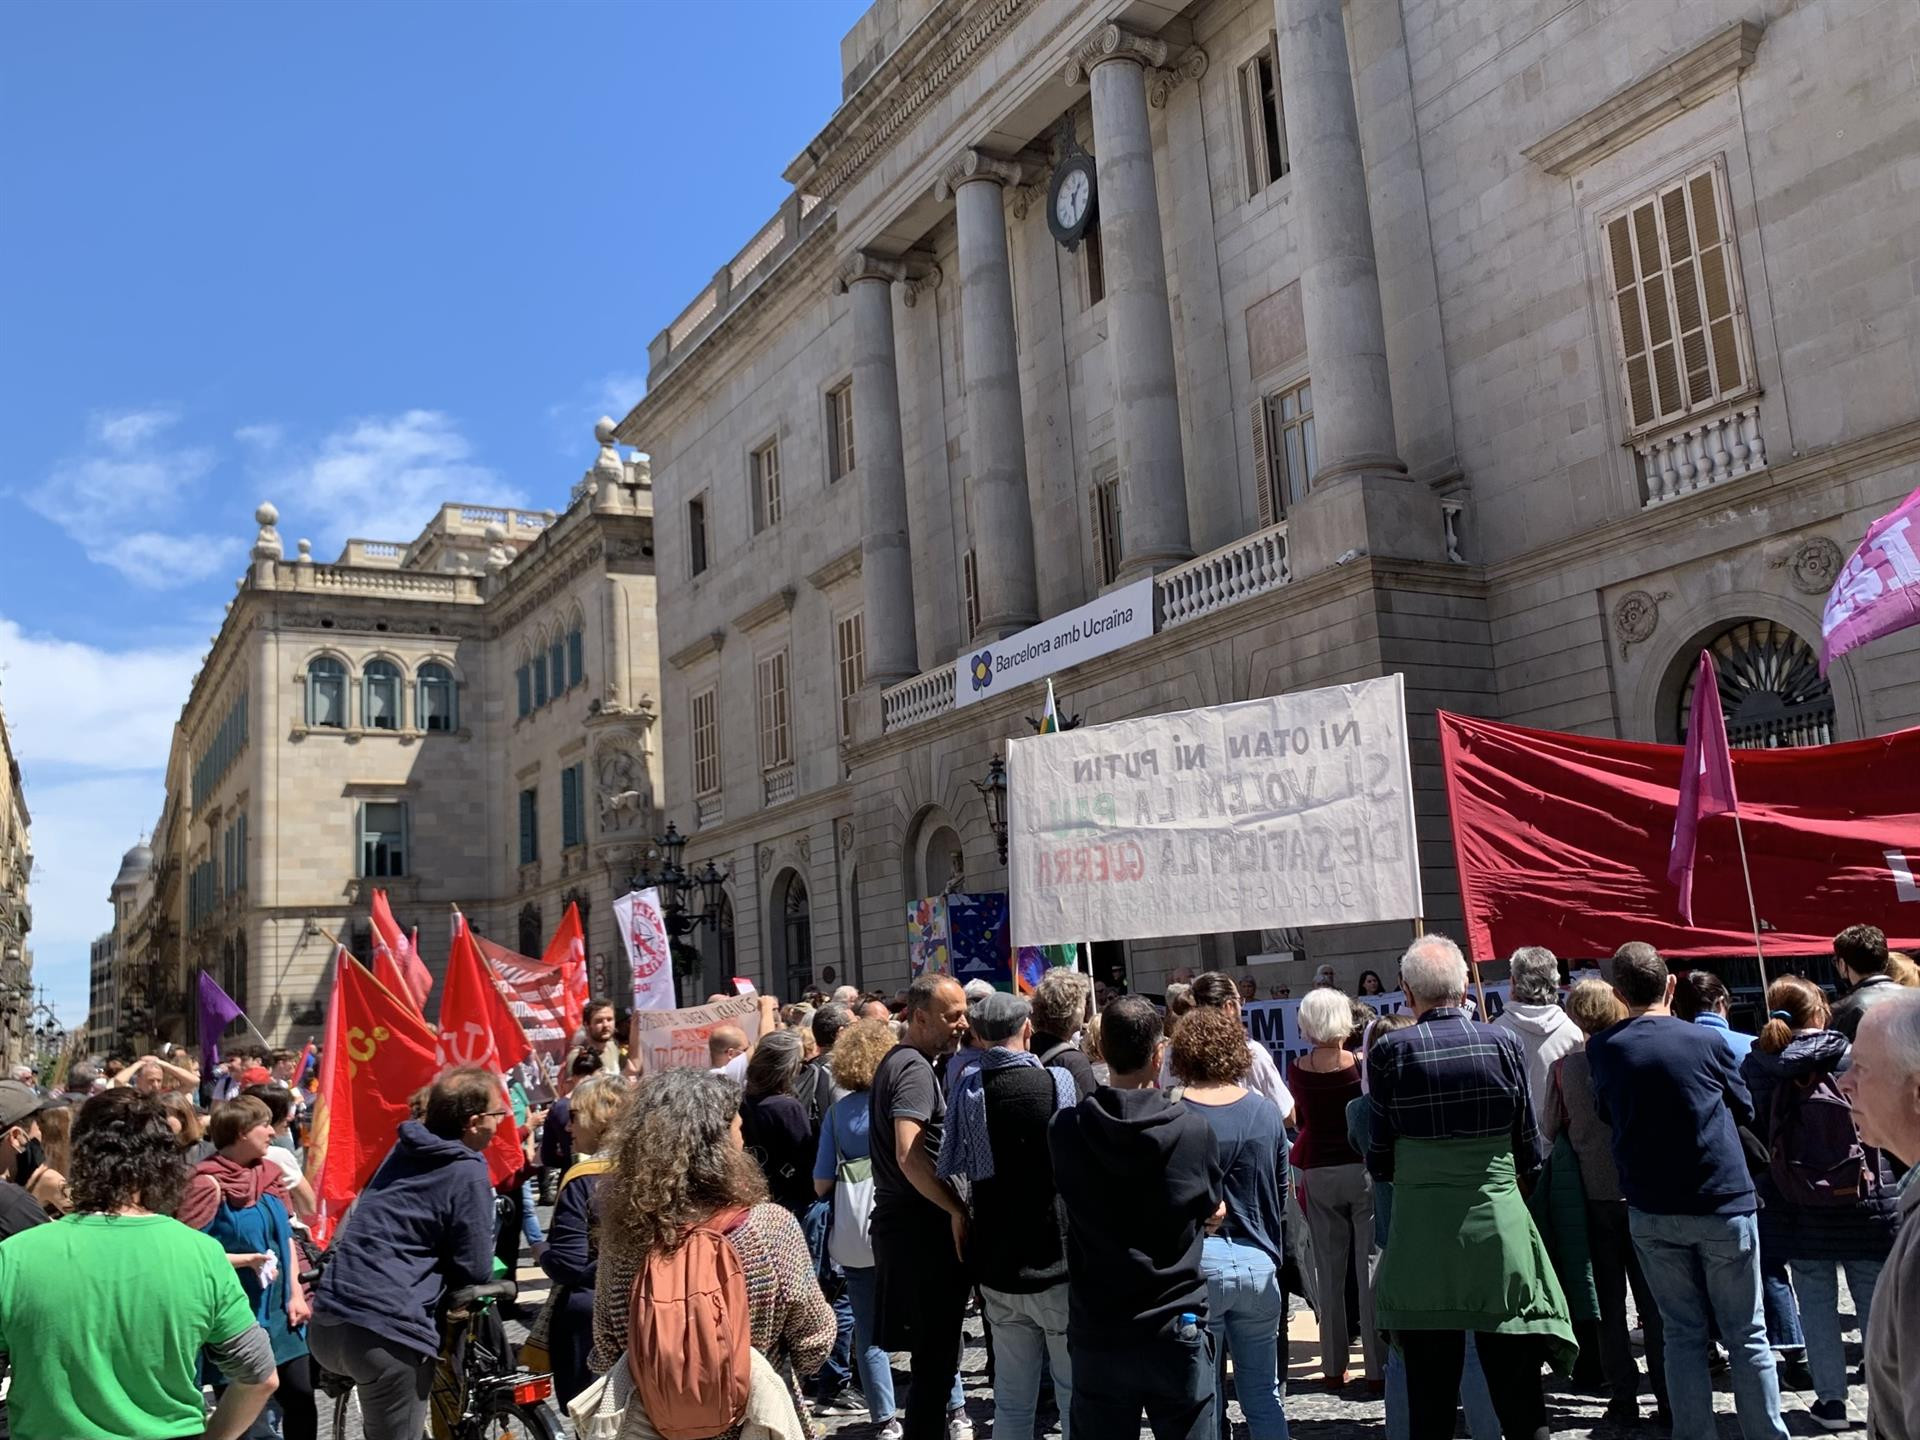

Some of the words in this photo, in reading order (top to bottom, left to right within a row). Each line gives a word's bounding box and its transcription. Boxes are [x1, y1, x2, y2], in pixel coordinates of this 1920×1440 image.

[995, 639, 1051, 673] Barcelona
[1053, 624, 1081, 650] amb
[1083, 607, 1133, 638] Ucraïna
